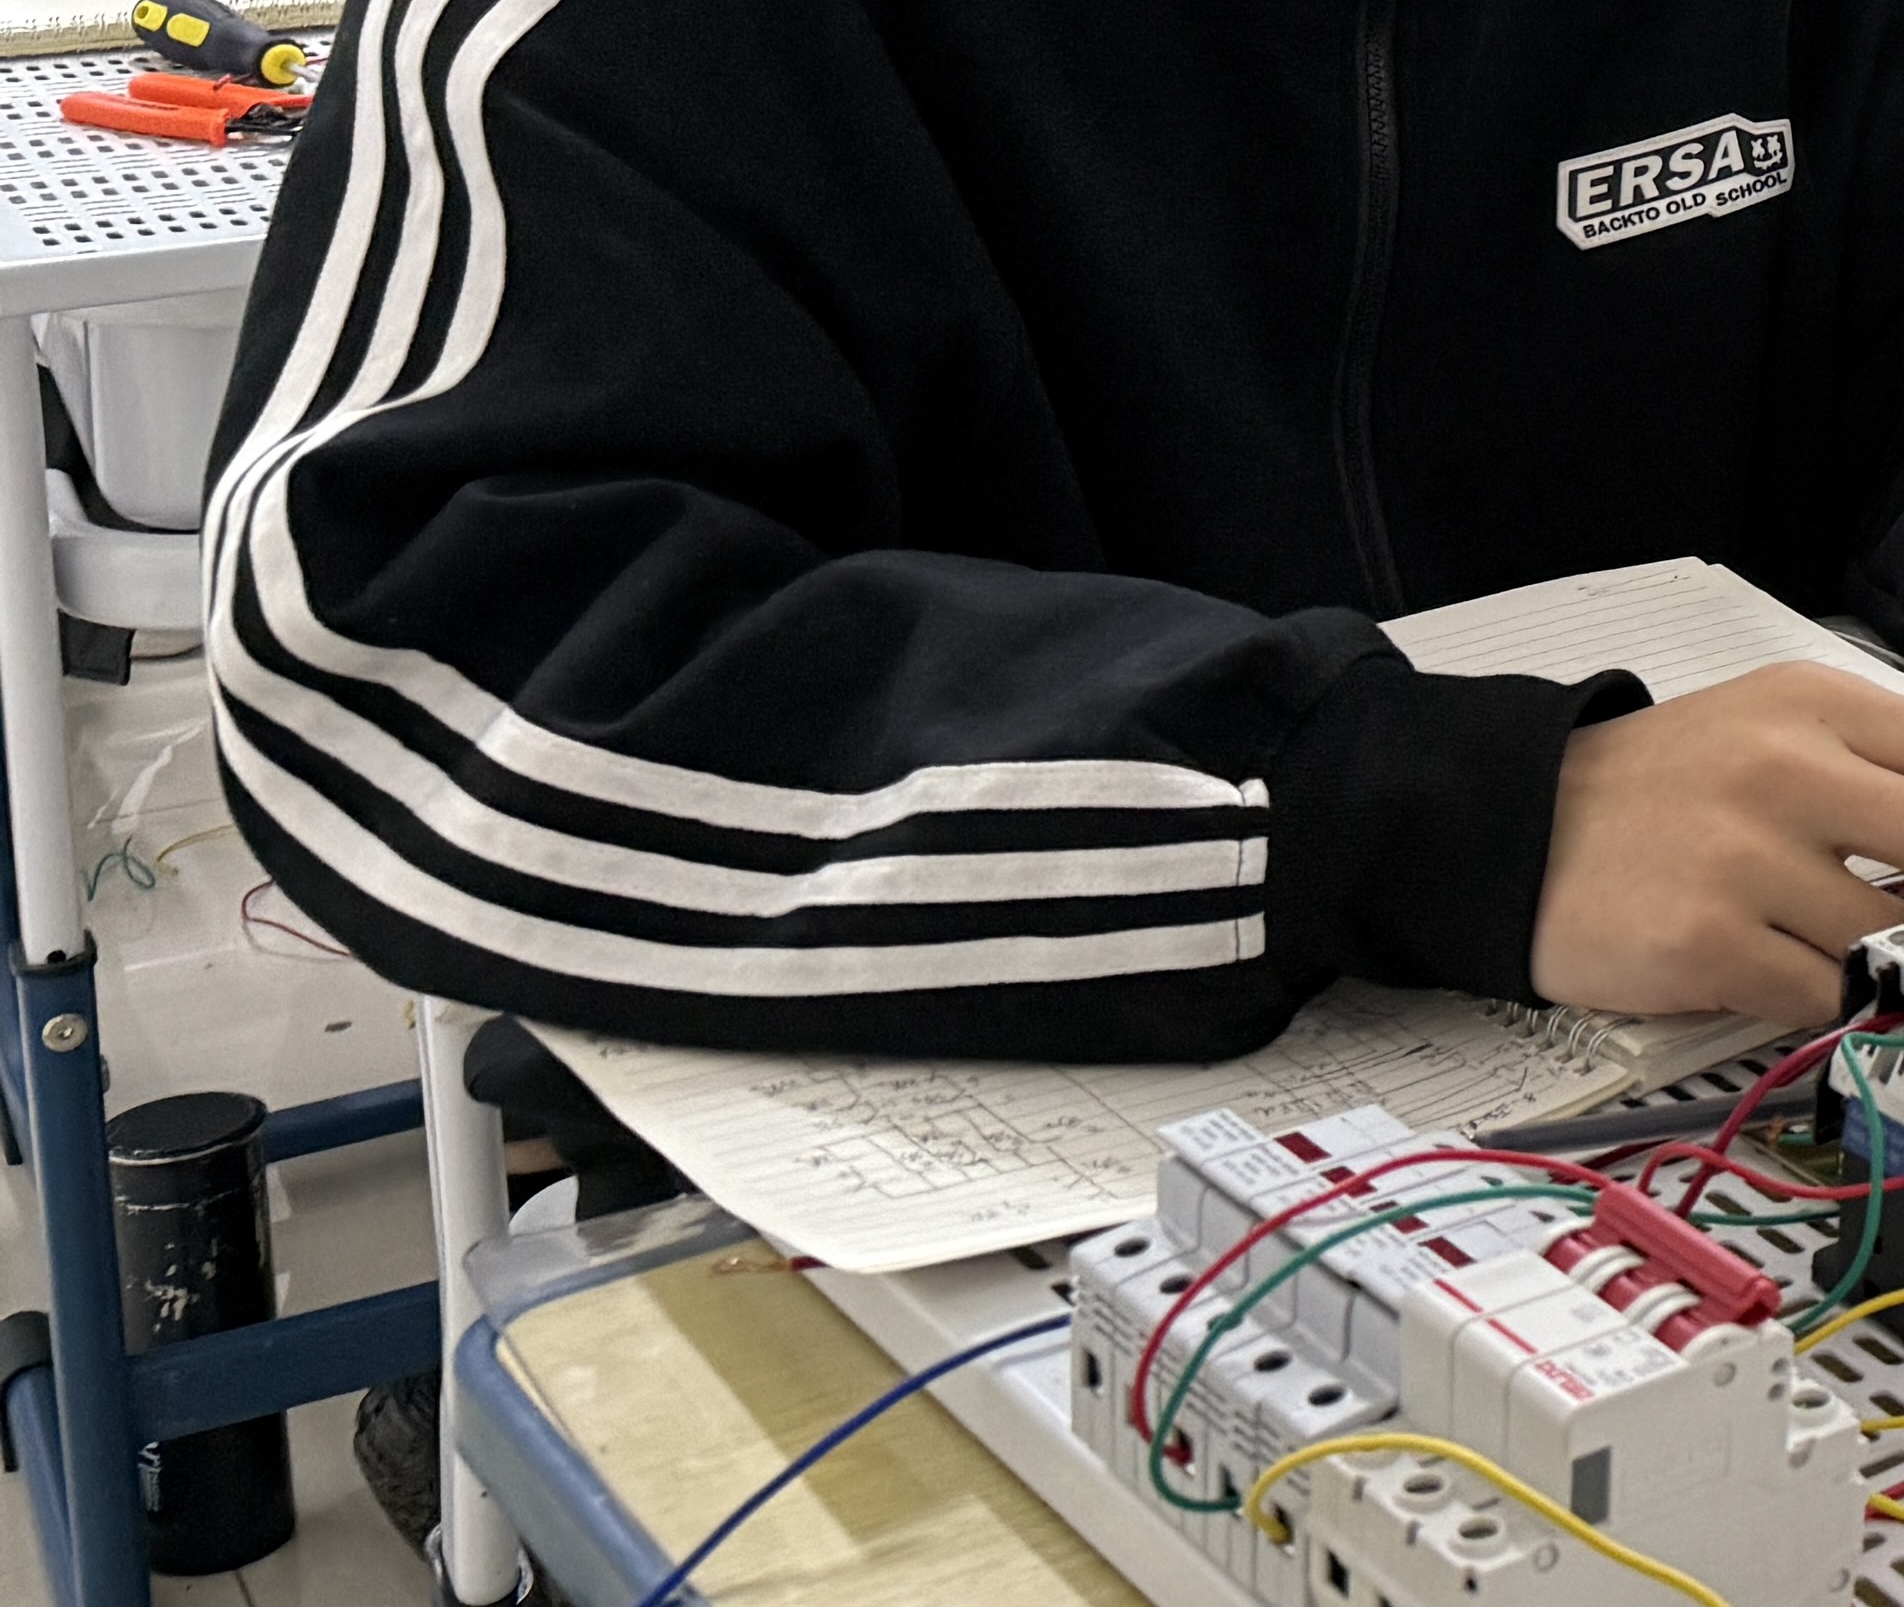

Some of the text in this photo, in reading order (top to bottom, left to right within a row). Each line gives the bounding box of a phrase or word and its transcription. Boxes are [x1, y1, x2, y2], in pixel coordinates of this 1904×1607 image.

[1575, 129, 1745, 219] ERSA
[1665, 192, 1707, 216] OLD
[1715, 171, 1788, 207] SCHOOL
